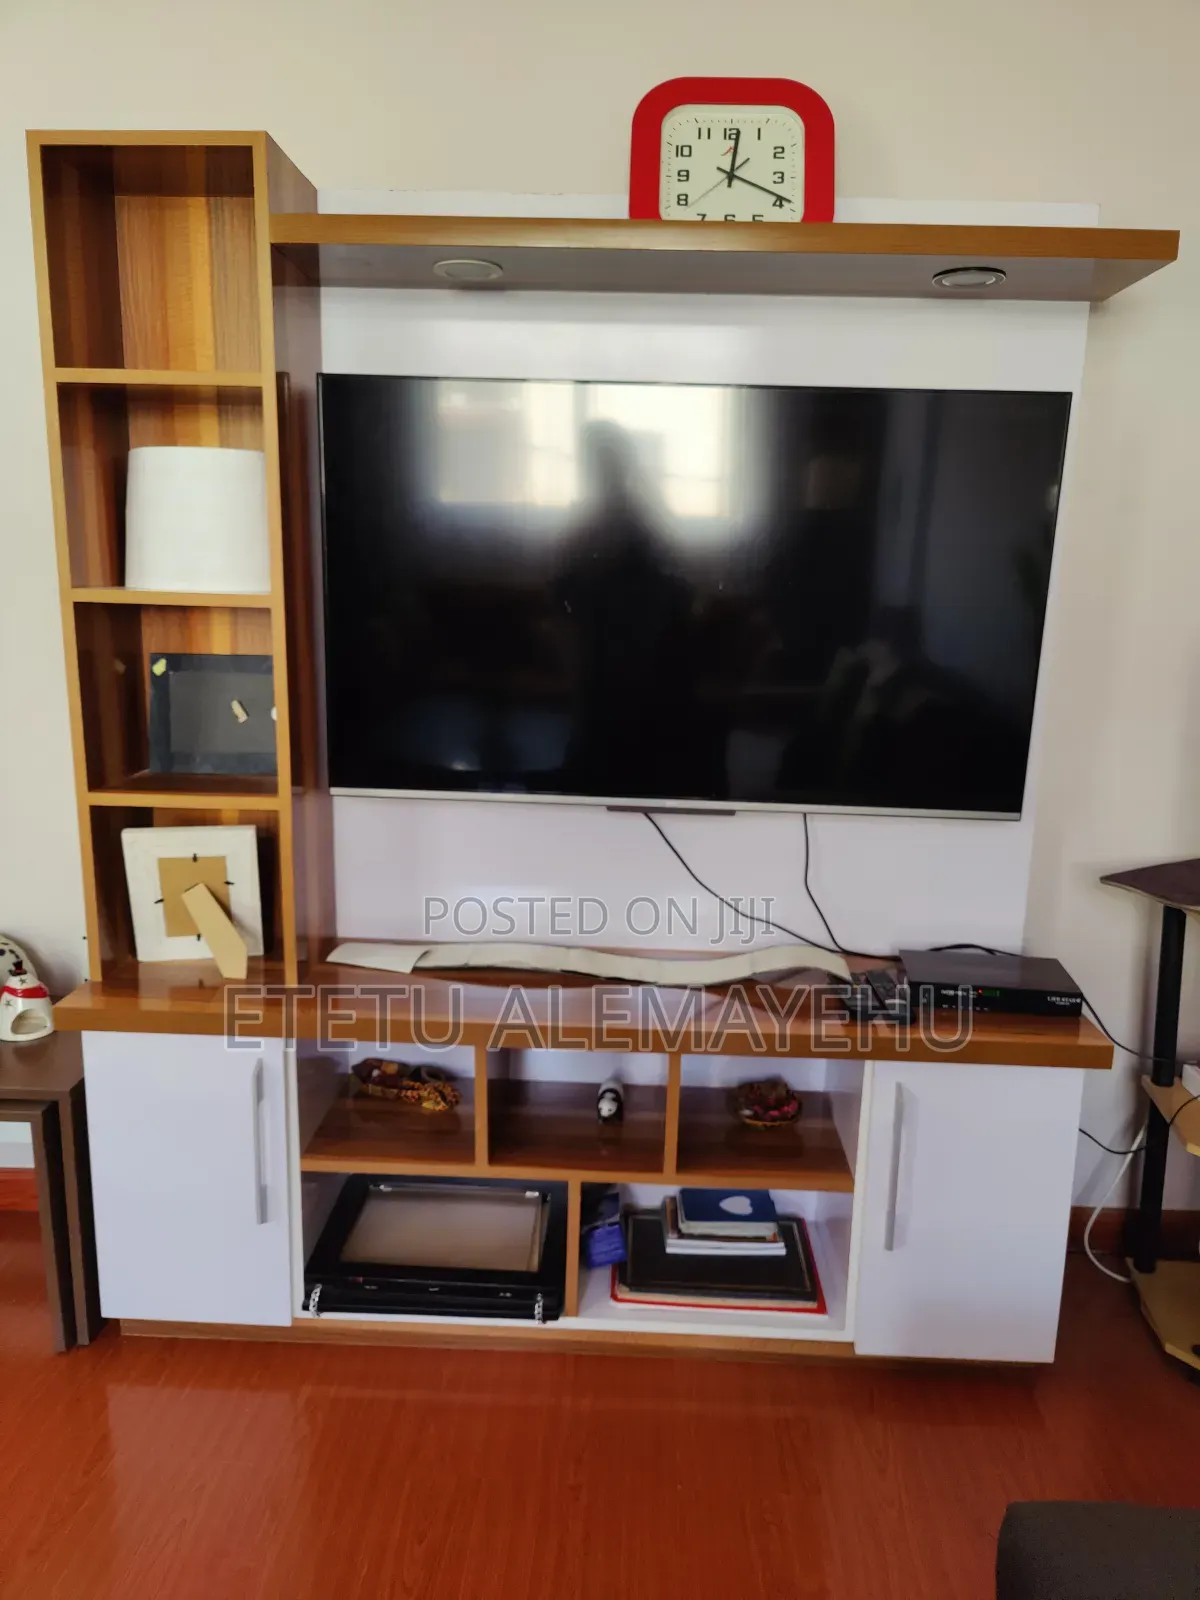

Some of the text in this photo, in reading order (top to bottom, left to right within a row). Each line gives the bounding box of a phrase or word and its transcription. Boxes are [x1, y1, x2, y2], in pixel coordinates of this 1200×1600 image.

[697, 128, 711, 140] 11
[723, 128, 740, 141] 12
[757, 128, 761, 141] 1
[675, 145, 692, 158] 10
[773, 146, 785, 159] 2
[677, 170, 690, 182] 9
[773, 171, 785, 184] 3
[676, 194, 688, 206] 8
[772, 195, 784, 209] 4
